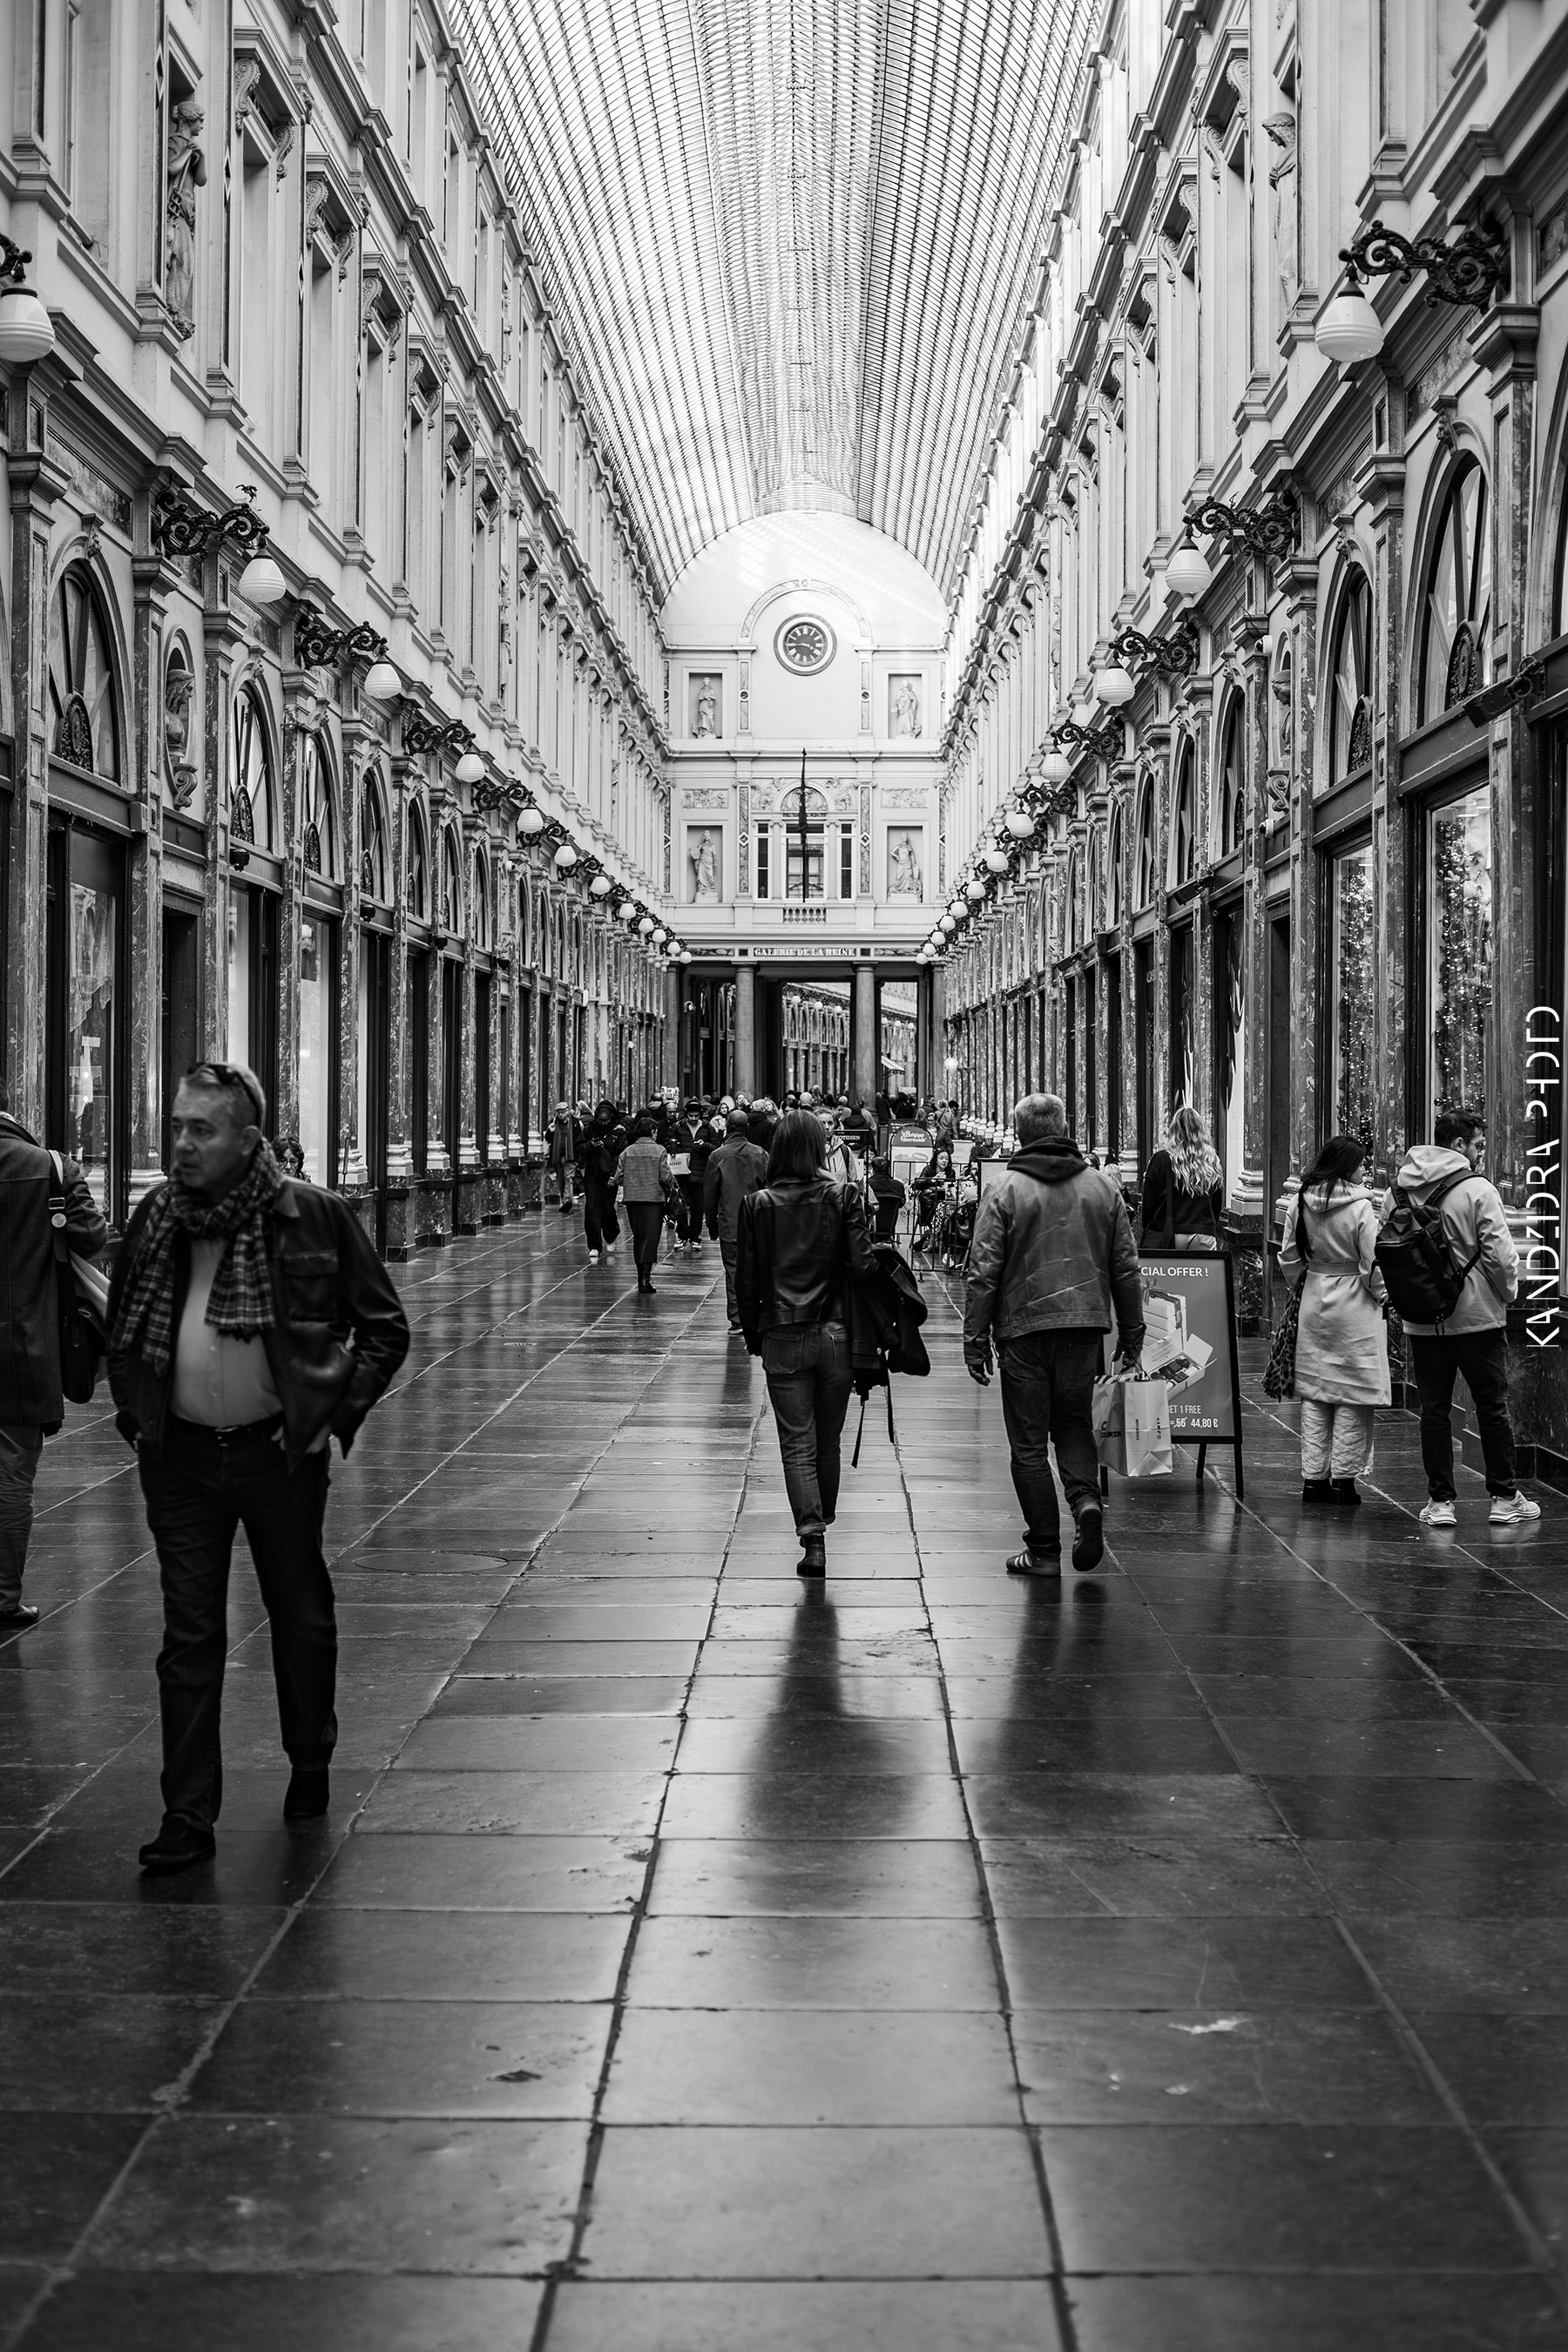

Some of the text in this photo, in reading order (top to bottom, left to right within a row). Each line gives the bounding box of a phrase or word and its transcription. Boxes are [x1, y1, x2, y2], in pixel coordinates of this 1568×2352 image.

[825, 948, 855, 956] REINE
[1140, 1267, 1166, 1276] CIAL
[1167, 1267, 1203, 1277] OFFER
[1169, 1404, 1201, 1414] ET 1 FREE
